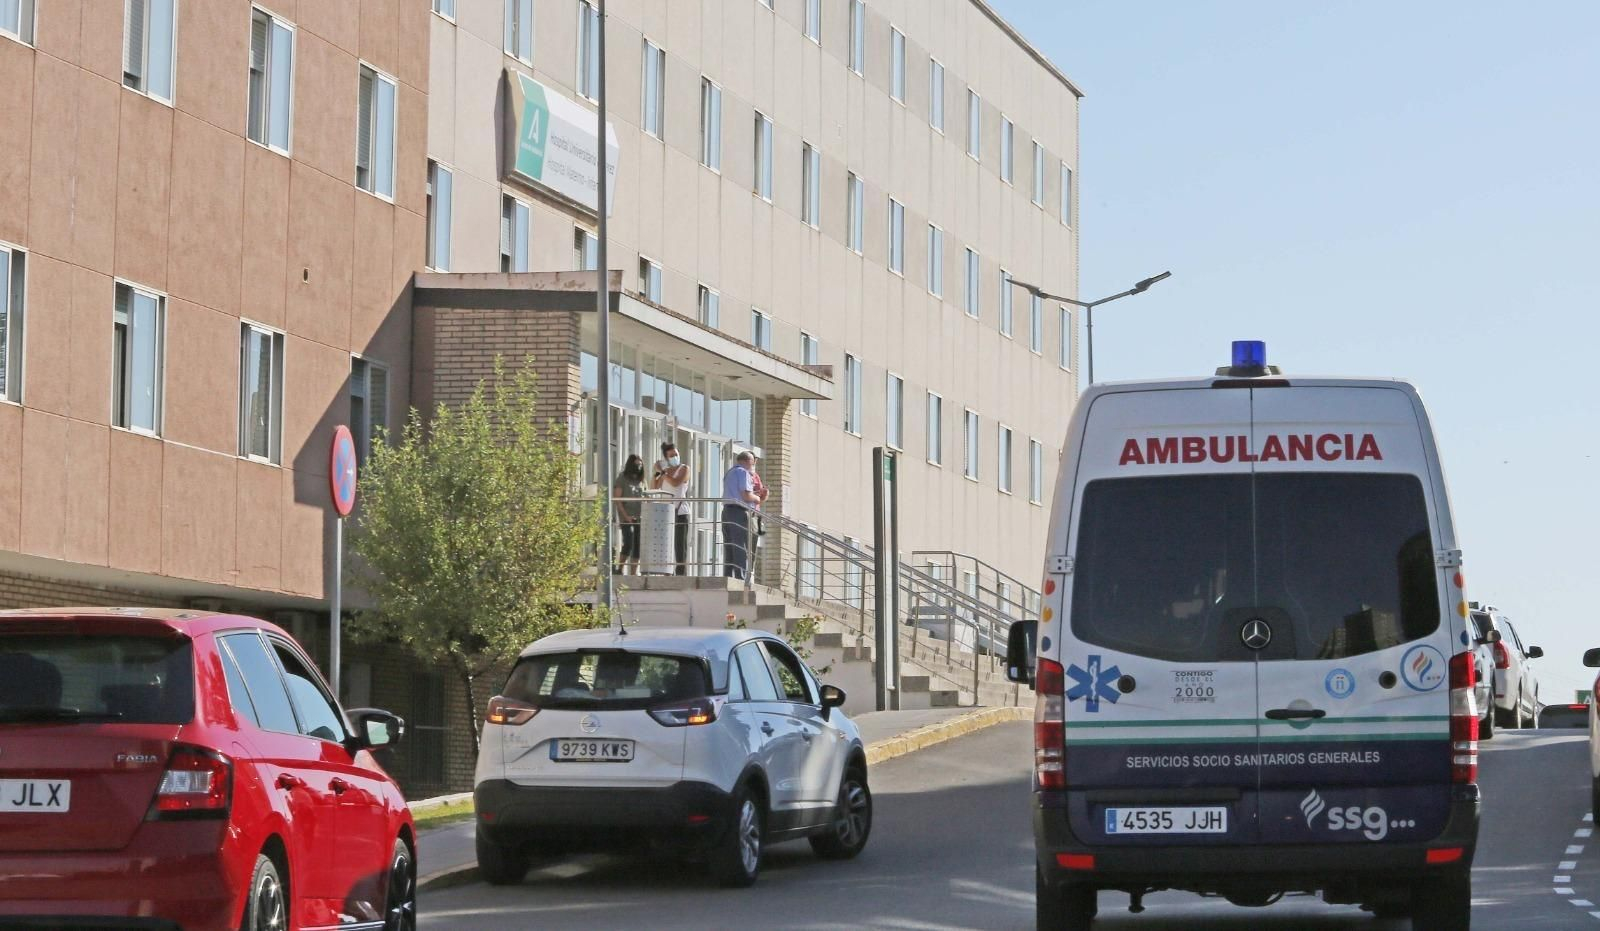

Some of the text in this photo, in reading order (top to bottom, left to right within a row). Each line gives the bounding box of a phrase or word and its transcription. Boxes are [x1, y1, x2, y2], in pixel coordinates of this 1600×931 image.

[1119, 434, 1383, 465] AMBULANCIA
[1175, 687, 1214, 697] 2000
[117, 754, 158, 763] FABIA
[562, 743, 629, 757] 9739 KWS
[1126, 751, 1381, 768] SERVICIOS SOCIO SANITARIOS GENERALES
[12, 783, 62, 806] JLX
[1123, 810, 1222, 830] 4535 JJH
